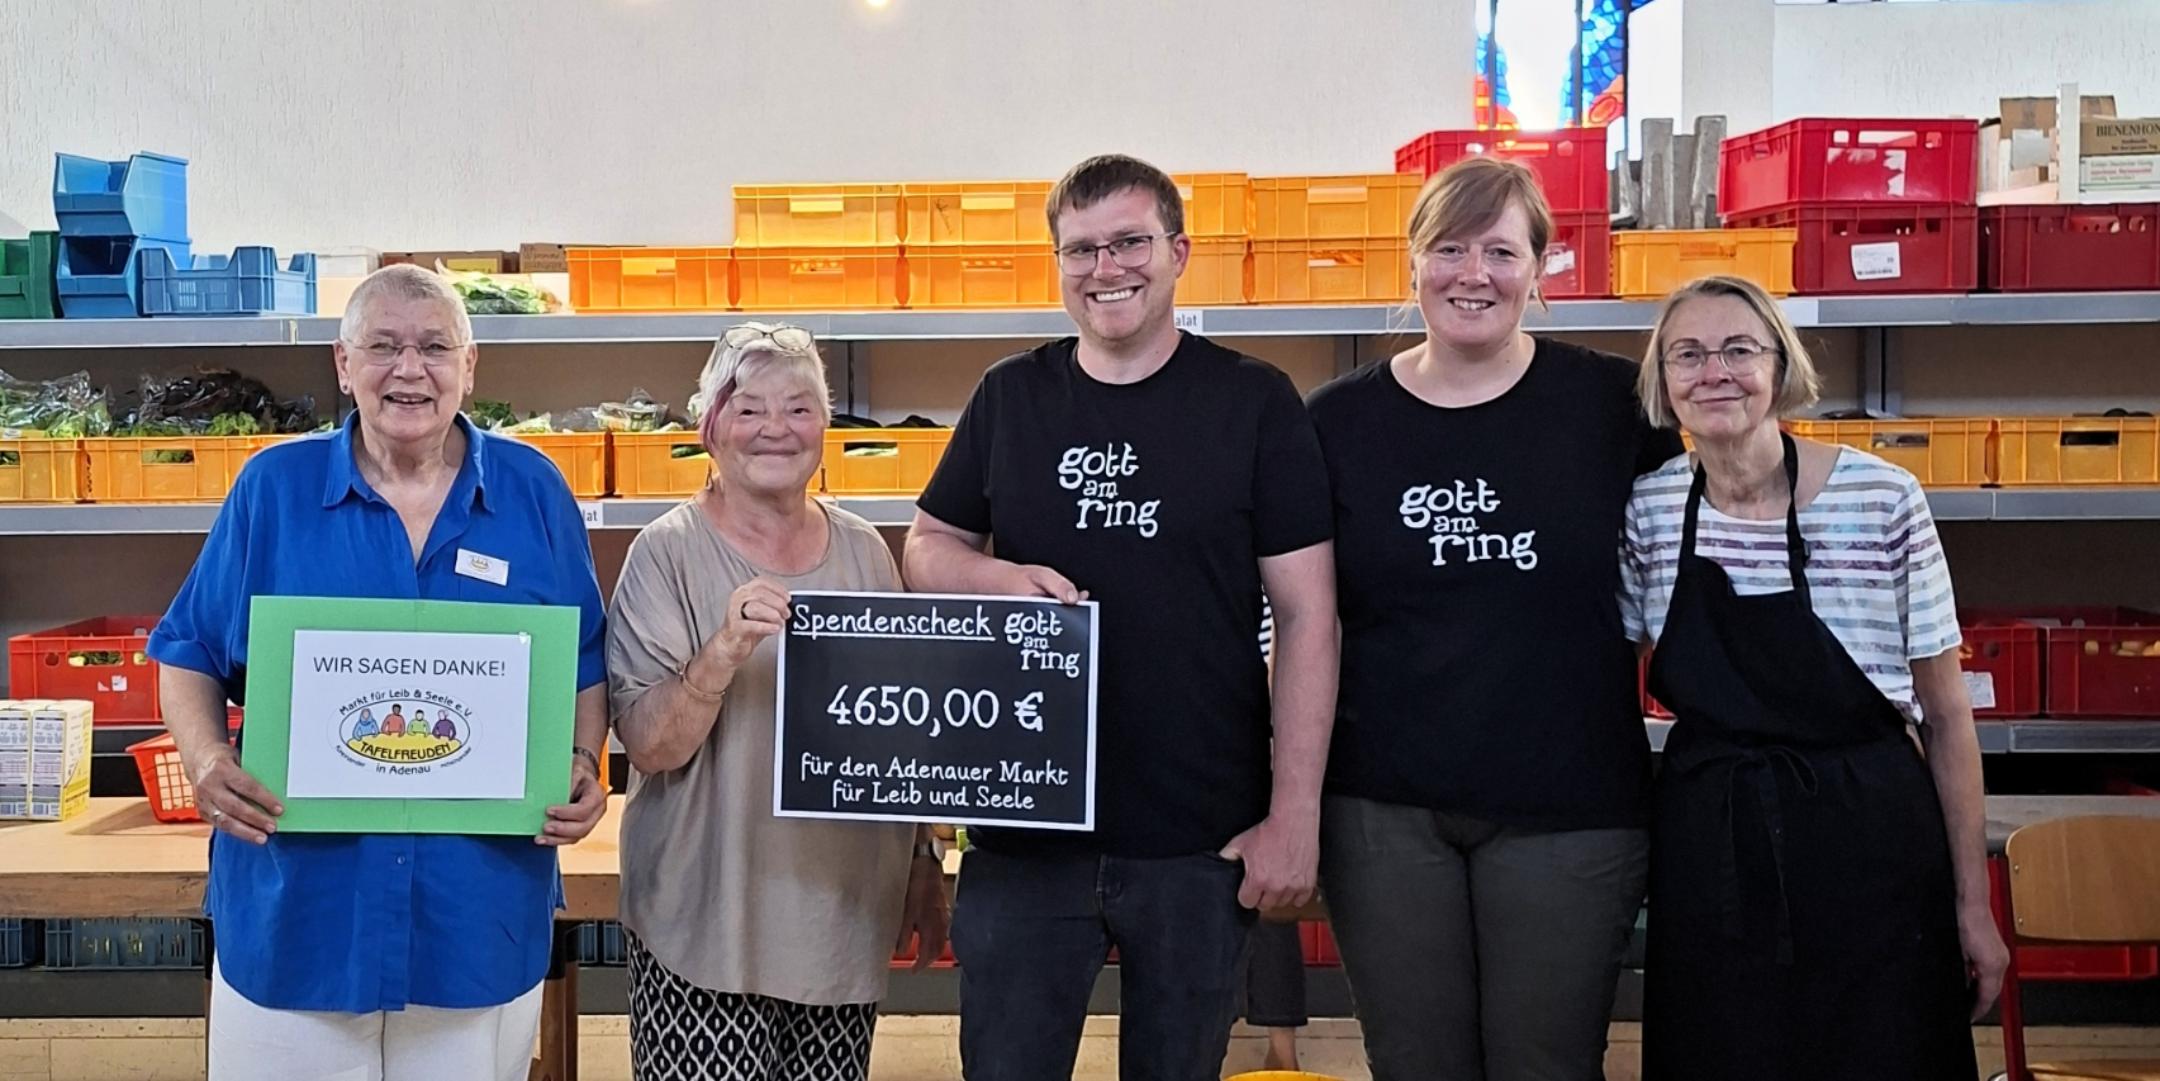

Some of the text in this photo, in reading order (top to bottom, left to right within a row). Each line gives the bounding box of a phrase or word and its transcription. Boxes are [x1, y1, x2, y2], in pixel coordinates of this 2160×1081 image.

[1058, 442, 1139, 489] gott
[1083, 480, 1118, 498] am
[1399, 478, 1501, 528] gott
[1076, 497, 1160, 538] ring
[1433, 515, 1480, 533] am
[1428, 530, 1537, 570] ring
[793, 604, 993, 640] Spendenscheck
[1004, 609, 1063, 644] gott
[1023, 635, 1049, 650] am
[313, 657, 506, 677] WIR SAGEN DANKE!
[1020, 648, 1080, 678] ring
[339, 696, 368, 716] Markt
[370, 691, 385, 701] für
[389, 689, 410, 698] Leib
[413, 689, 422, 698] &
[424, 691, 454, 706] Seele
[827, 684, 1044, 737] 4650,00 €
[360, 741, 451, 761] TAFELFREUDEN
[376, 763, 431, 775] in Adenau
[801, 752, 1069, 785] für den Adenauer Markt
[832, 779, 1035, 810] für Leib und Seele
